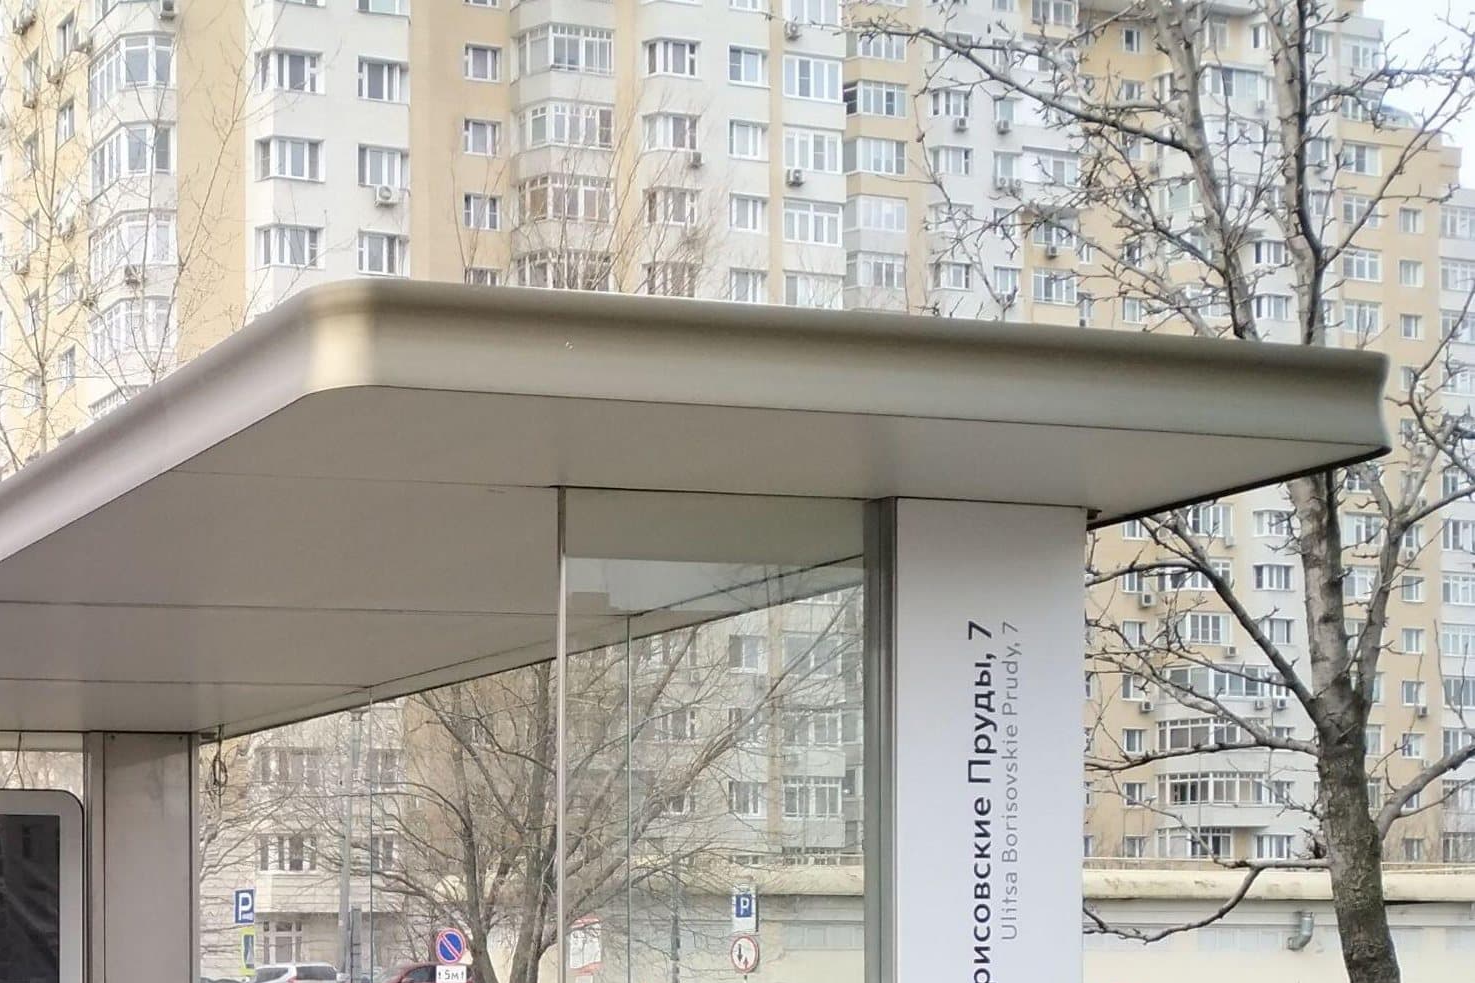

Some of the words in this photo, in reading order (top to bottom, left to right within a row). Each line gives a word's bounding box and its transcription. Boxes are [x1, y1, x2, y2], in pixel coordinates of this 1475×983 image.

[967, 620, 993, 641] 7
[1001, 621, 1019, 635] 7
[1000, 642, 1023, 716] Prudy,
[967, 652, 998, 783] Пруды,
[1000, 724, 1019, 863] Borisovskie
[238, 892, 253, 921] P
[1000, 871, 1018, 940] Ulitsa
